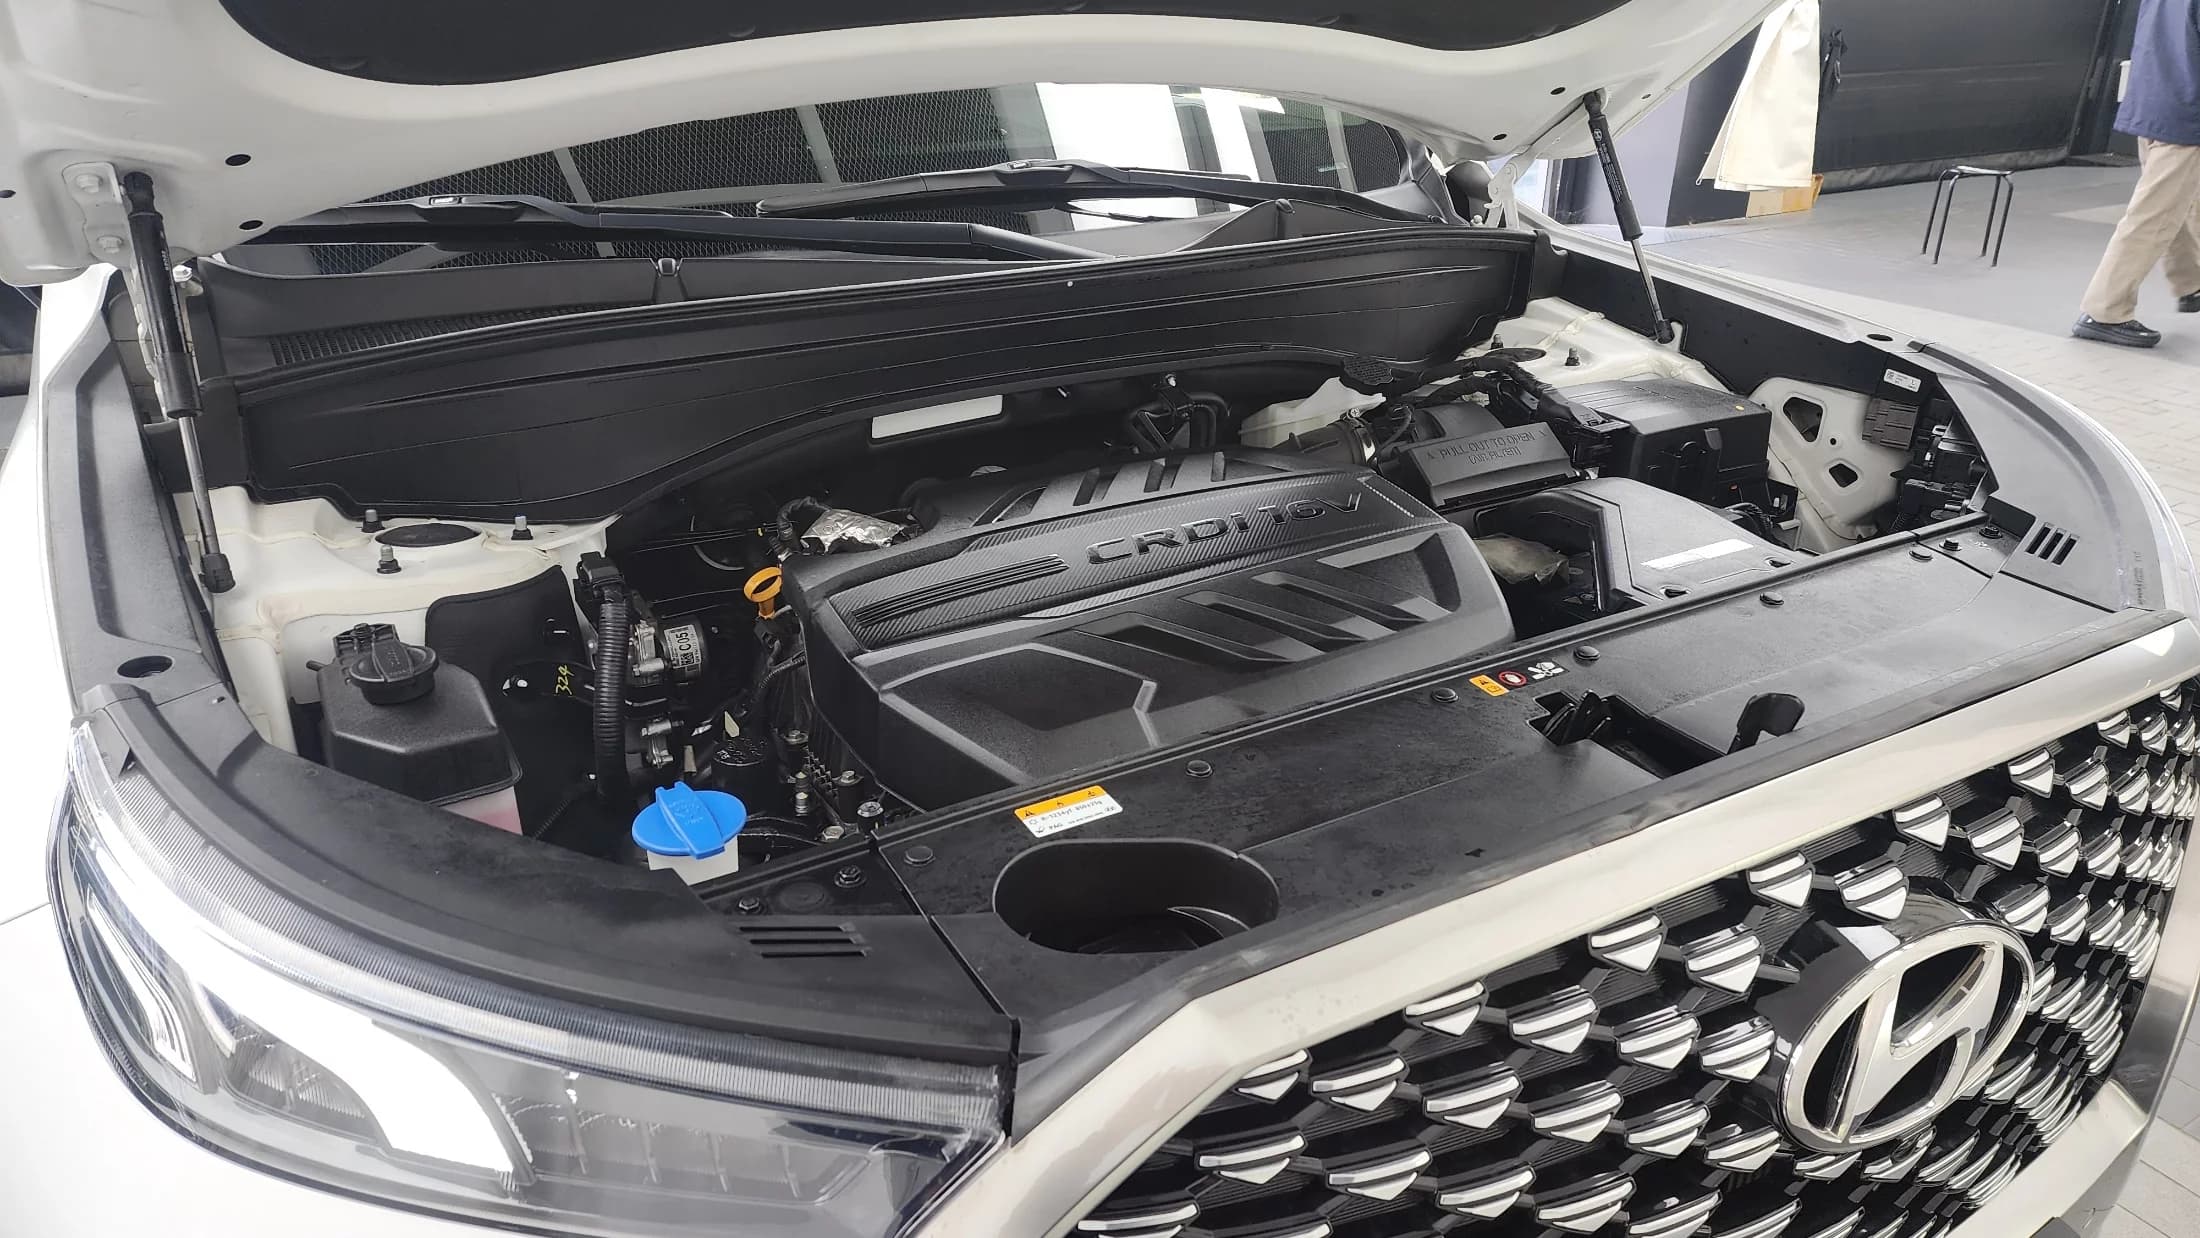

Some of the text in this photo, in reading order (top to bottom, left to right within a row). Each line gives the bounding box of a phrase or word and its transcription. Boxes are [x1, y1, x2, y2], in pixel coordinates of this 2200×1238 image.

[1440, 432, 1535, 458] PULL OUT TO OPEN
[1257, 491, 1361, 526] 16V
